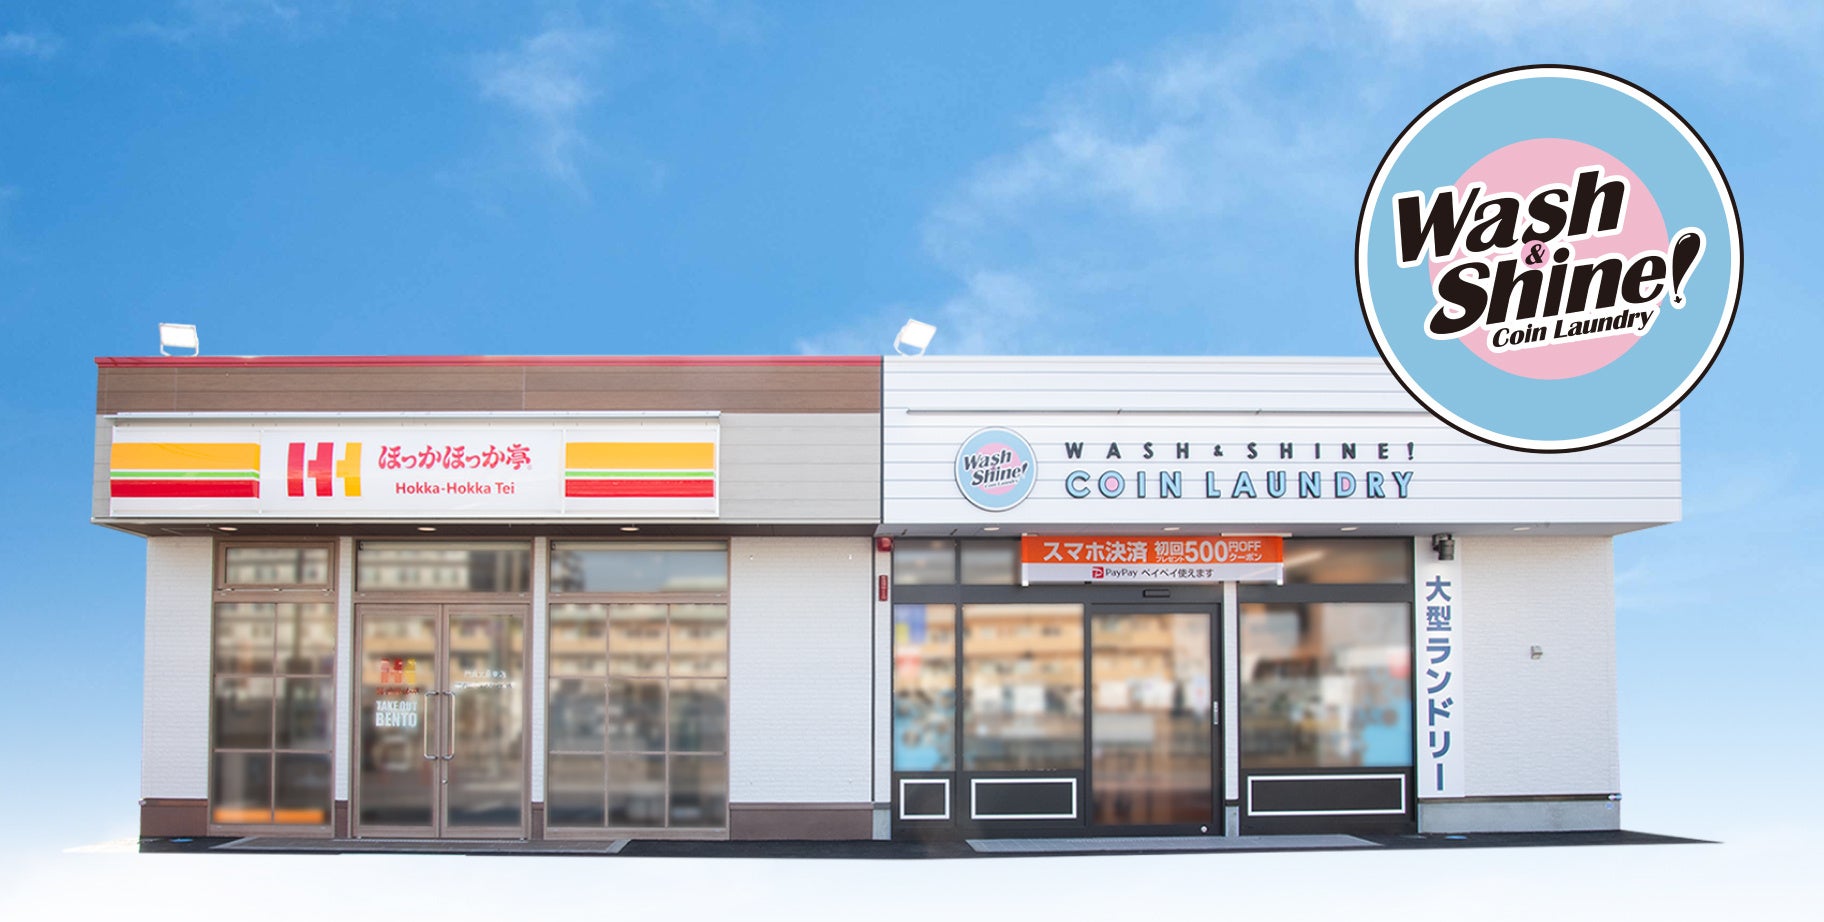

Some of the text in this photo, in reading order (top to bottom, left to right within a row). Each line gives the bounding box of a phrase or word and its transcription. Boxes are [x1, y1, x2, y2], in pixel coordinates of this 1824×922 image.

[378, 443, 531, 470] ほっかほっか亭
[963, 449, 1012, 470] Wash
[1065, 442, 1415, 461] WASH & SHINE!
[395, 482, 515, 495] Hokka-Hokka Tei
[1065, 470, 1414, 499] COIN LAUNDRY
[1043, 541, 1148, 562] スマホ決済
[1155, 541, 1184, 556] 初回
[1105, 568, 1138, 578] PayPay
[1426, 575, 1454, 791] 大型ランドリー
[376, 700, 400, 711] TAKE
[375, 712, 418, 727] BENTO
